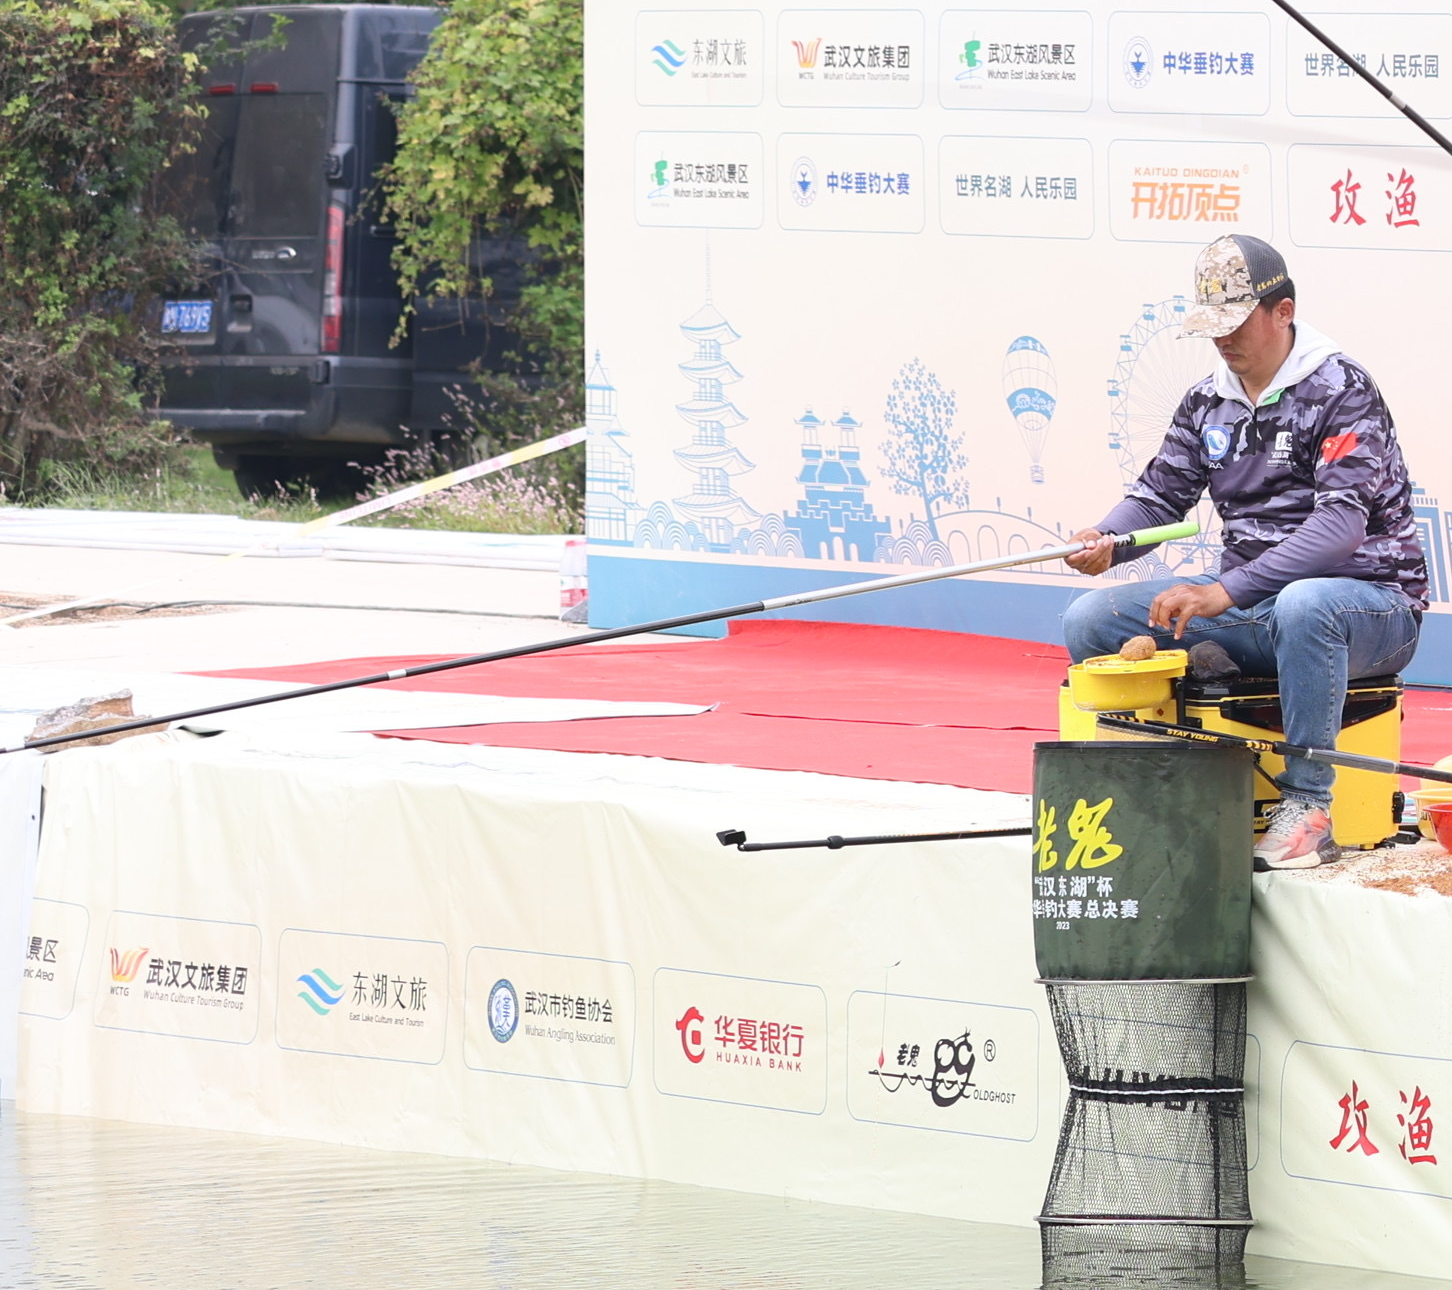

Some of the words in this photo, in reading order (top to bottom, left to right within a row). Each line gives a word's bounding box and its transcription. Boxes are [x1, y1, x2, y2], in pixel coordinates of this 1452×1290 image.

[693, 39, 746, 65] 东湖文旅
[824, 46, 909, 68] 武汉文旅集团
[988, 44, 1075, 64] 武汉东湖风景区
[1164, 51, 1254, 75] 中华垂钓大赛
[1375, 54, 1438, 81] 人民乐园
[674, 164, 748, 183] 武汉东湖风景区
[827, 172, 909, 195] 中华垂钓大赛
[956, 175, 1011, 198] 世界名湖
[1021, 176, 1076, 200] 人民乐园
[1131, 182, 1240, 222] 开拓顶点
[1167, 729, 1188, 738] STAY
[1189, 731, 1219, 743] YOUNG
[145, 957, 249, 996] 武汉文旅集团
[351, 972, 427, 1014] 东湖文旅
[525, 992, 612, 1022] 武汉市钓鱼协会
[523, 1023, 546, 1038] Wuhan
[546, 1026, 574, 1044] Angling
[574, 1029, 616, 1046] Association
[713, 1015, 805, 1058] 华夏银行
[715, 1050, 762, 1068] HUAXIA
[768, 1057, 803, 1073] BANK
[974, 1089, 1016, 1104] OLDGHOST
